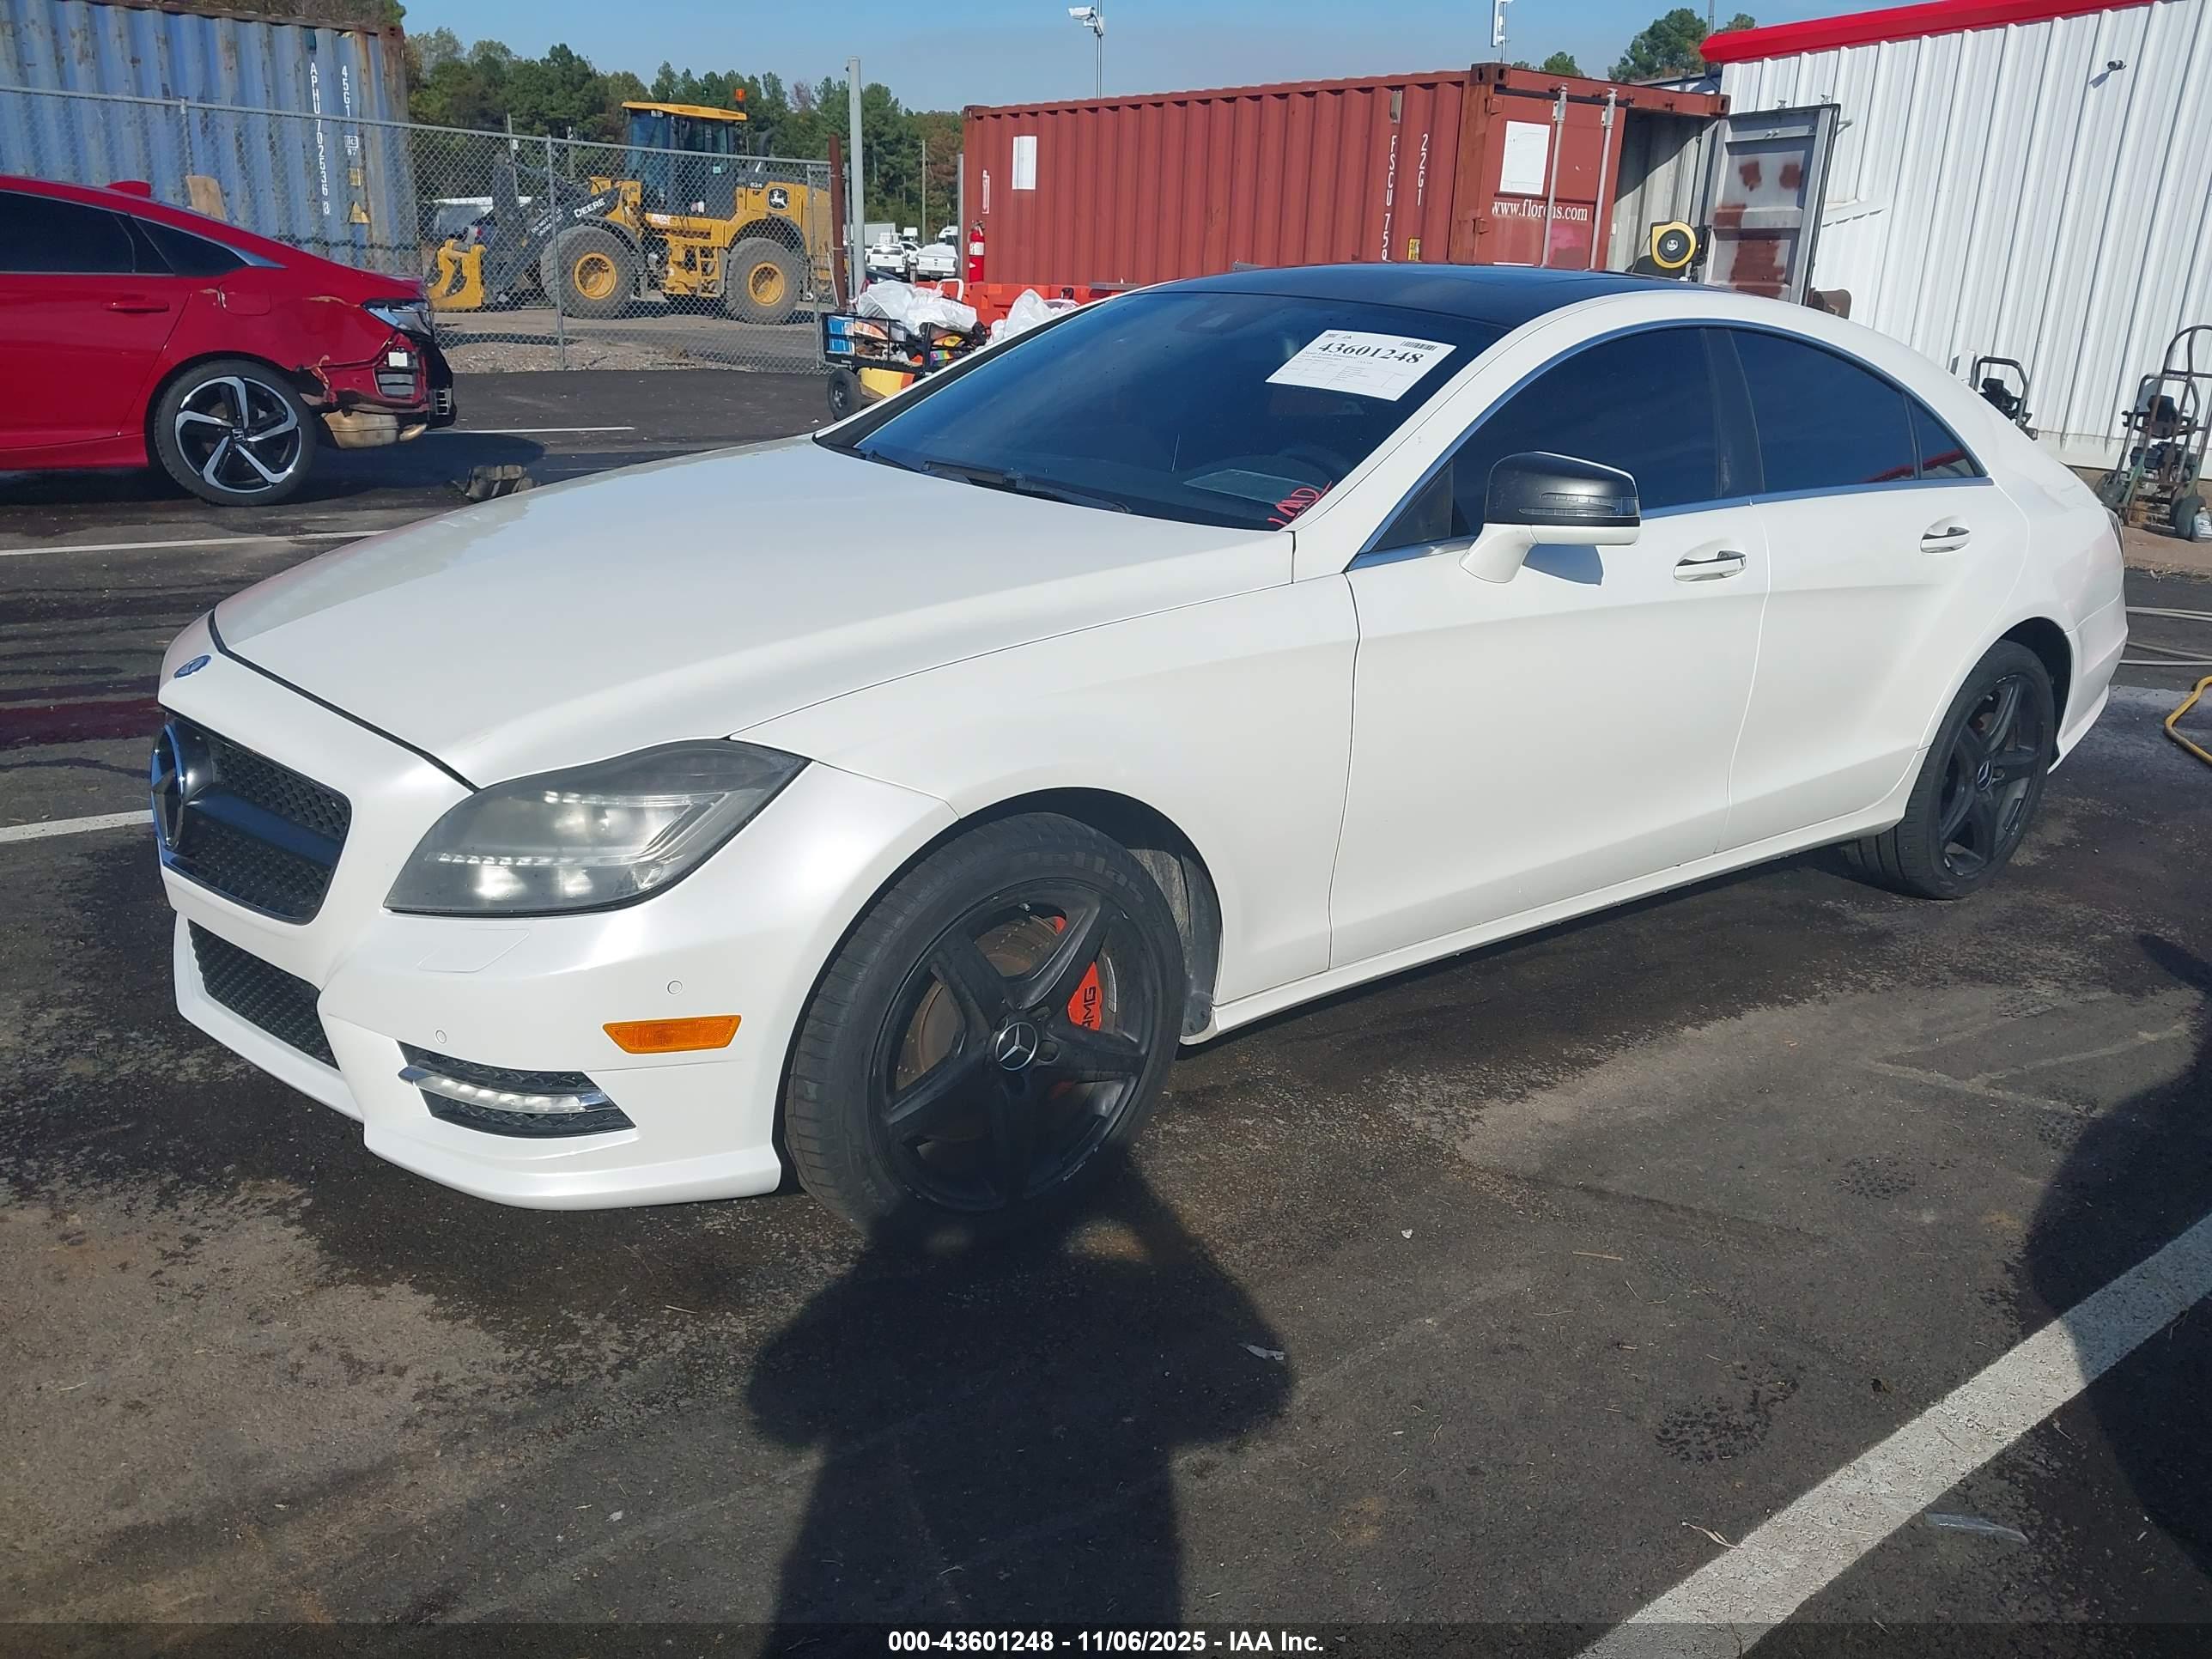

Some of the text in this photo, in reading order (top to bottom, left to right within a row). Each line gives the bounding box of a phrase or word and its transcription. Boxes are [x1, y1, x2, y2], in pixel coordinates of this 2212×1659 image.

[310, 62, 321, 114] APHU
[342, 65, 350, 117] 45G1
[315, 119, 328, 196] 702536
[1386, 135, 1397, 206] FSCU
[1417, 133, 1429, 206] 22G1
[574, 198, 605, 218] DEERE
[1318, 342, 1425, 364] 43601248
[1082, 986, 1097, 1027] AMG
